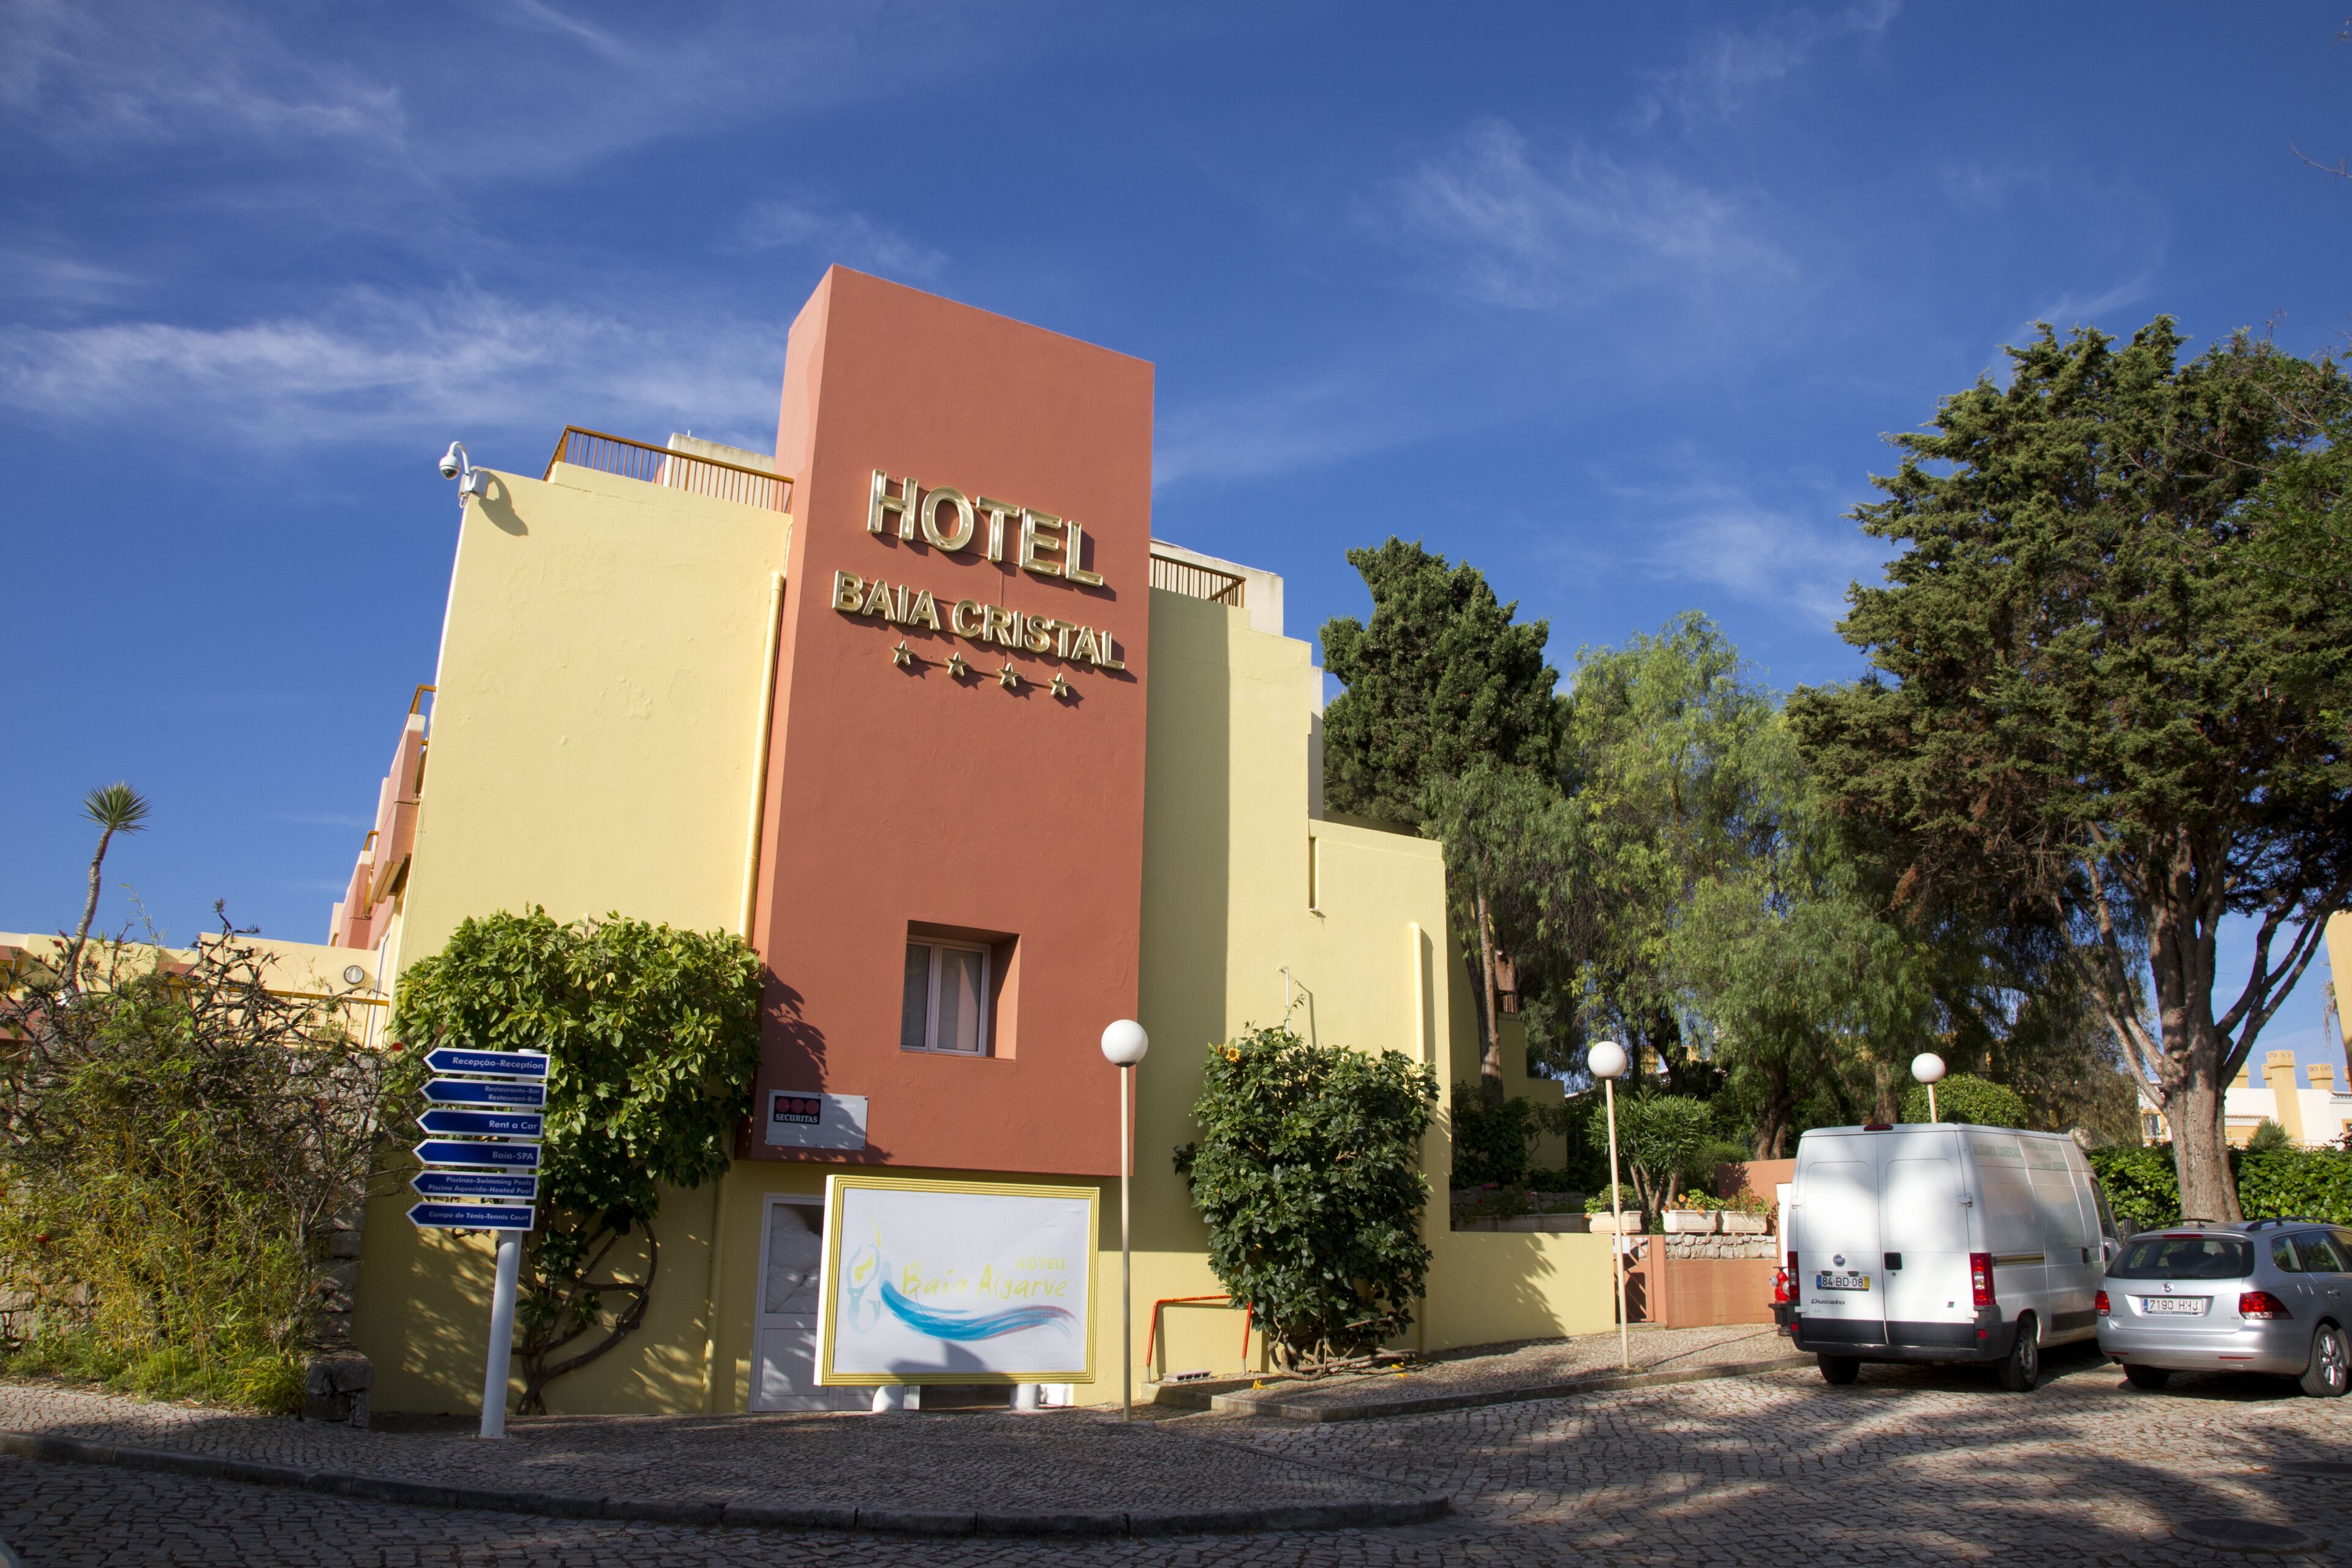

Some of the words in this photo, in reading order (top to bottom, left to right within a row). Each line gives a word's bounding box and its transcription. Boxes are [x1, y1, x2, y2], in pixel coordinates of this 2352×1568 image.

[867, 469, 1103, 587] HOTEL
[832, 570, 941, 630] BAIA
[952, 598, 1125, 670] CRISTAL
[452, 1057, 544, 1069] Recepção-Reception
[775, 1114, 818, 1123] SECURITAS
[492, 1151, 533, 1160] Baía-SPA
[446, 1177, 512, 1186] Piscinas-Swimming
[1015, 1257, 1066, 1271] HOTELS
[977, 1264, 1068, 1300] Algarve
[2149, 1300, 2174, 1310] 7190
[2179, 1300, 2199, 1311] HHJ
